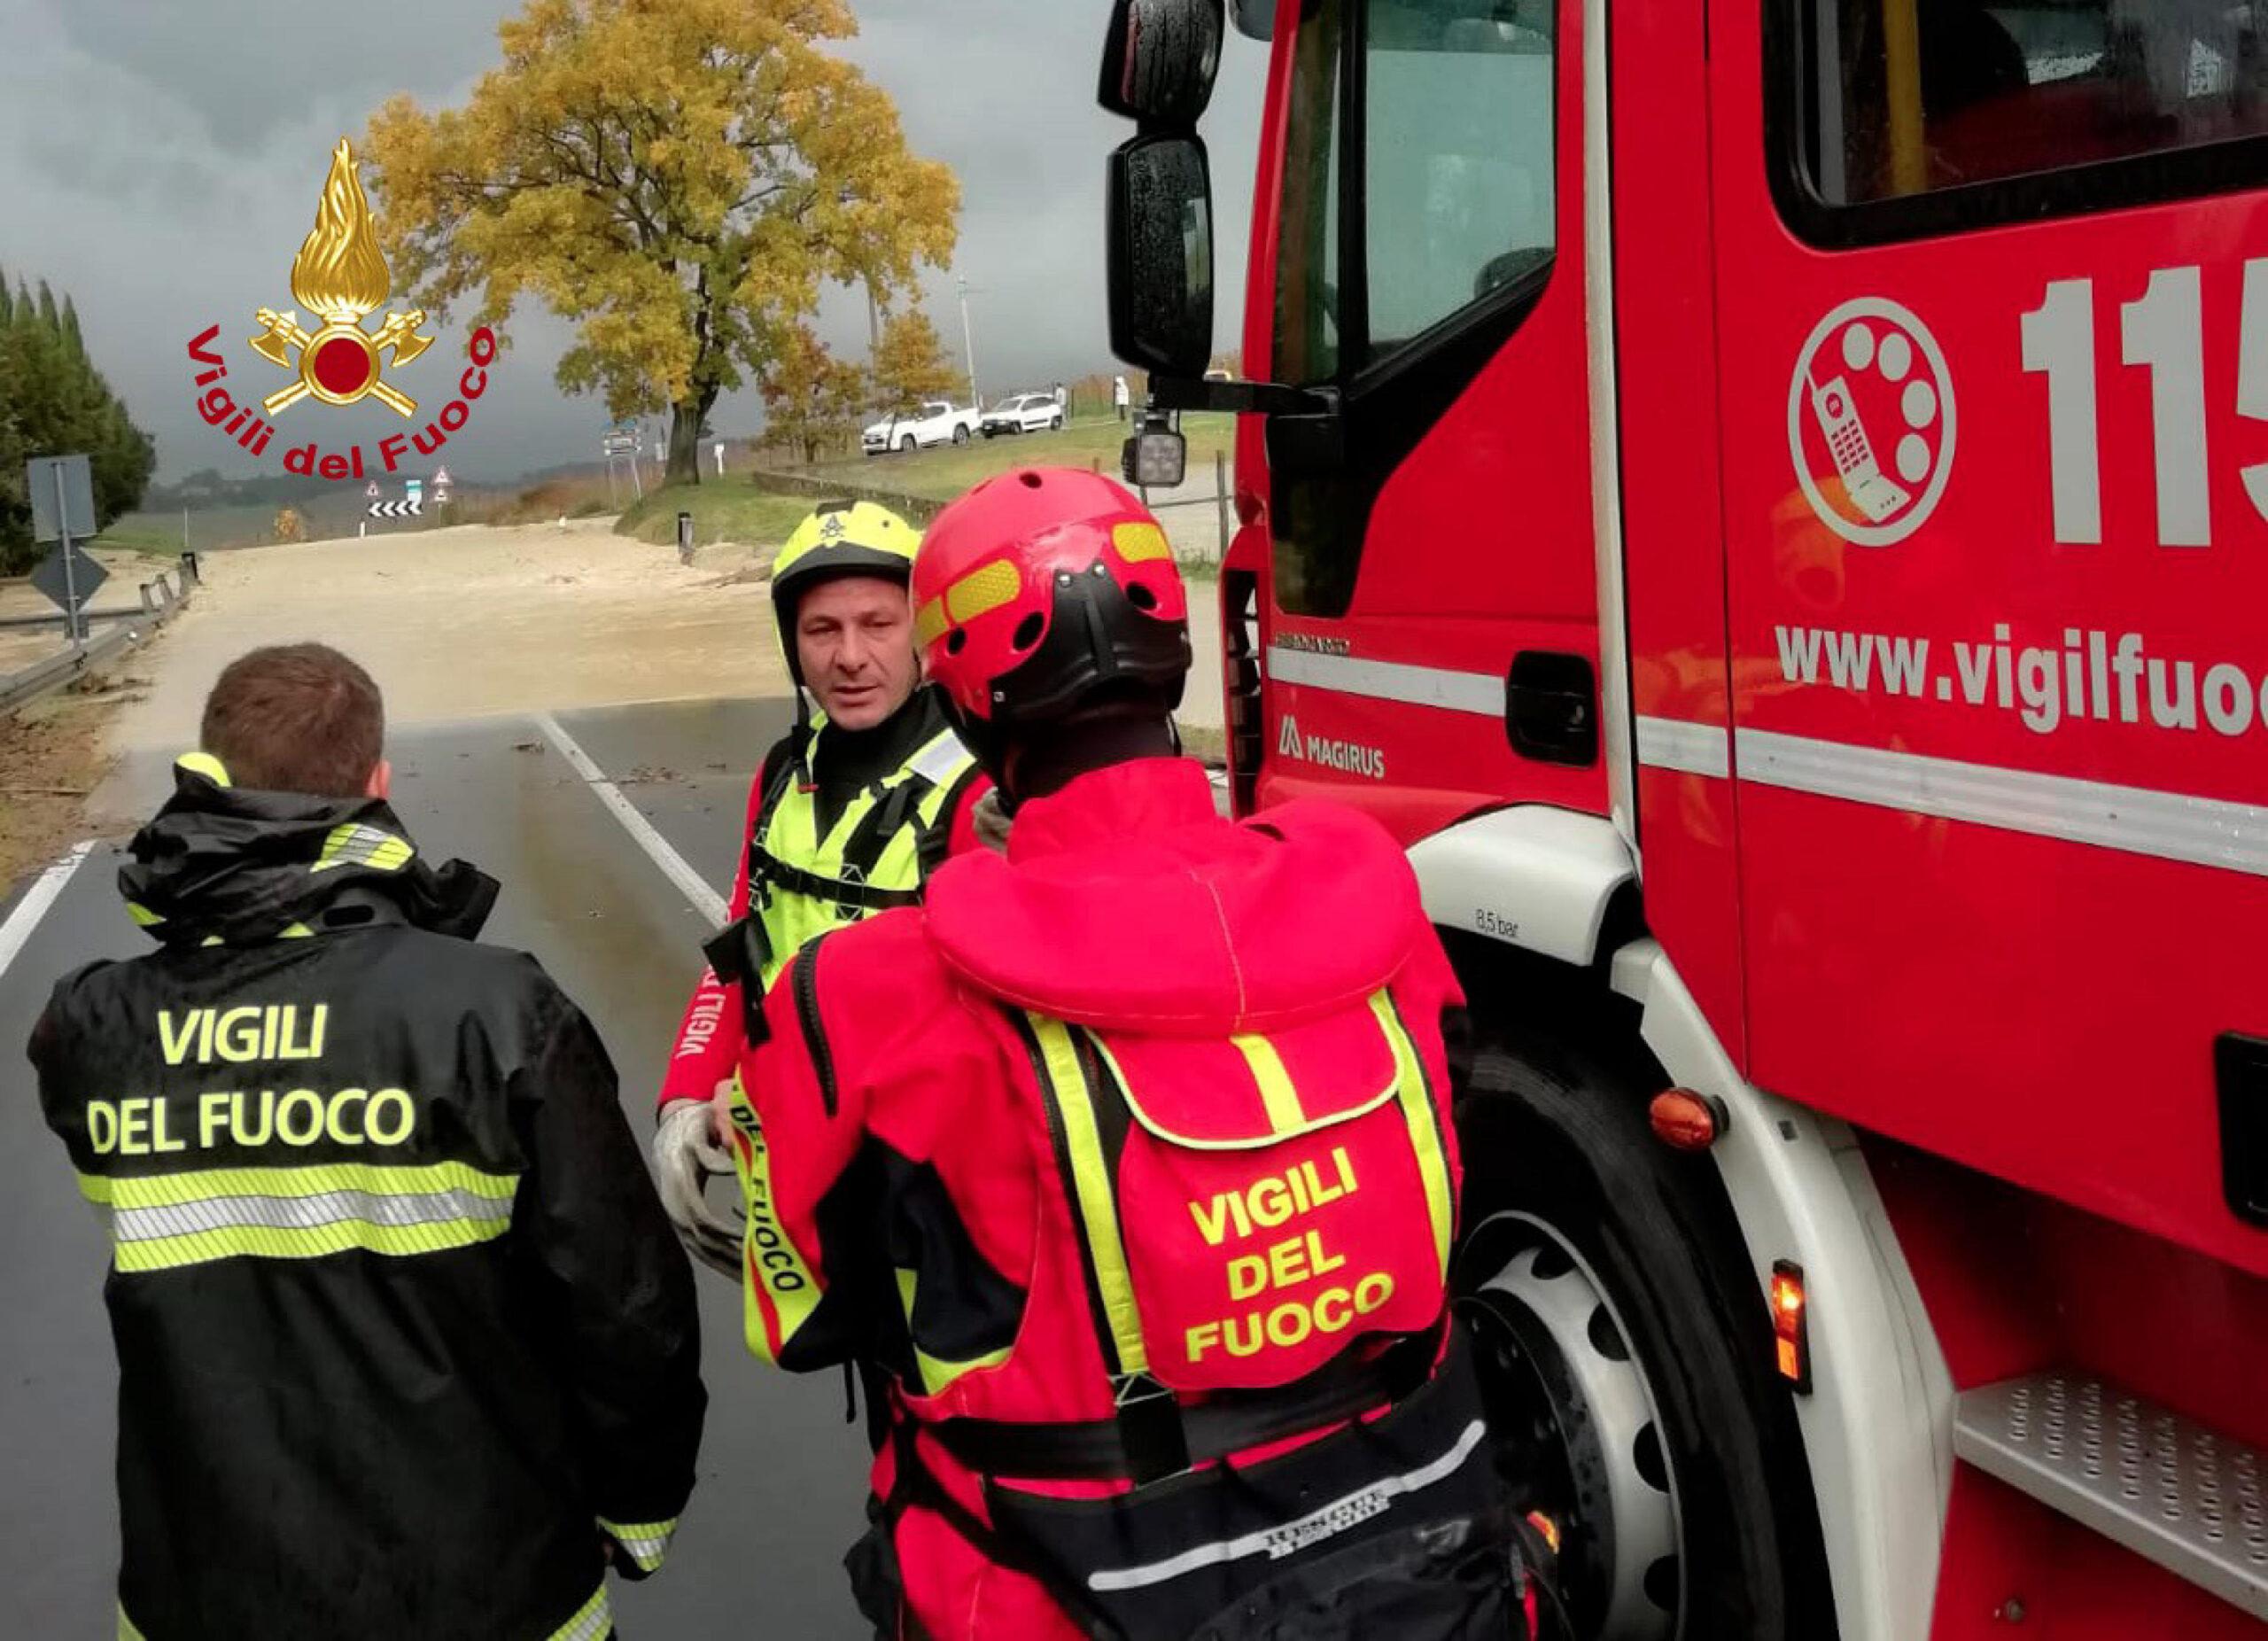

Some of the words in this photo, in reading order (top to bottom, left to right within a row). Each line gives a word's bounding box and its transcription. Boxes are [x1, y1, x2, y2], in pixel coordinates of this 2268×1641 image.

[1775, 624, 2268, 735] www.vigilfuo
[1307, 735, 1386, 780] MAGIRUS
[158, 1004, 328, 1064] VIGILI
[675, 993, 726, 1060] VIGILI
[88, 1097, 186, 1155] DEL
[199, 1088, 415, 1148] FUOCO
[1187, 1147, 1358, 1246] VIGILI
[1227, 1229, 1346, 1301] DEL
[1185, 1272, 1394, 1363] FUOCO
